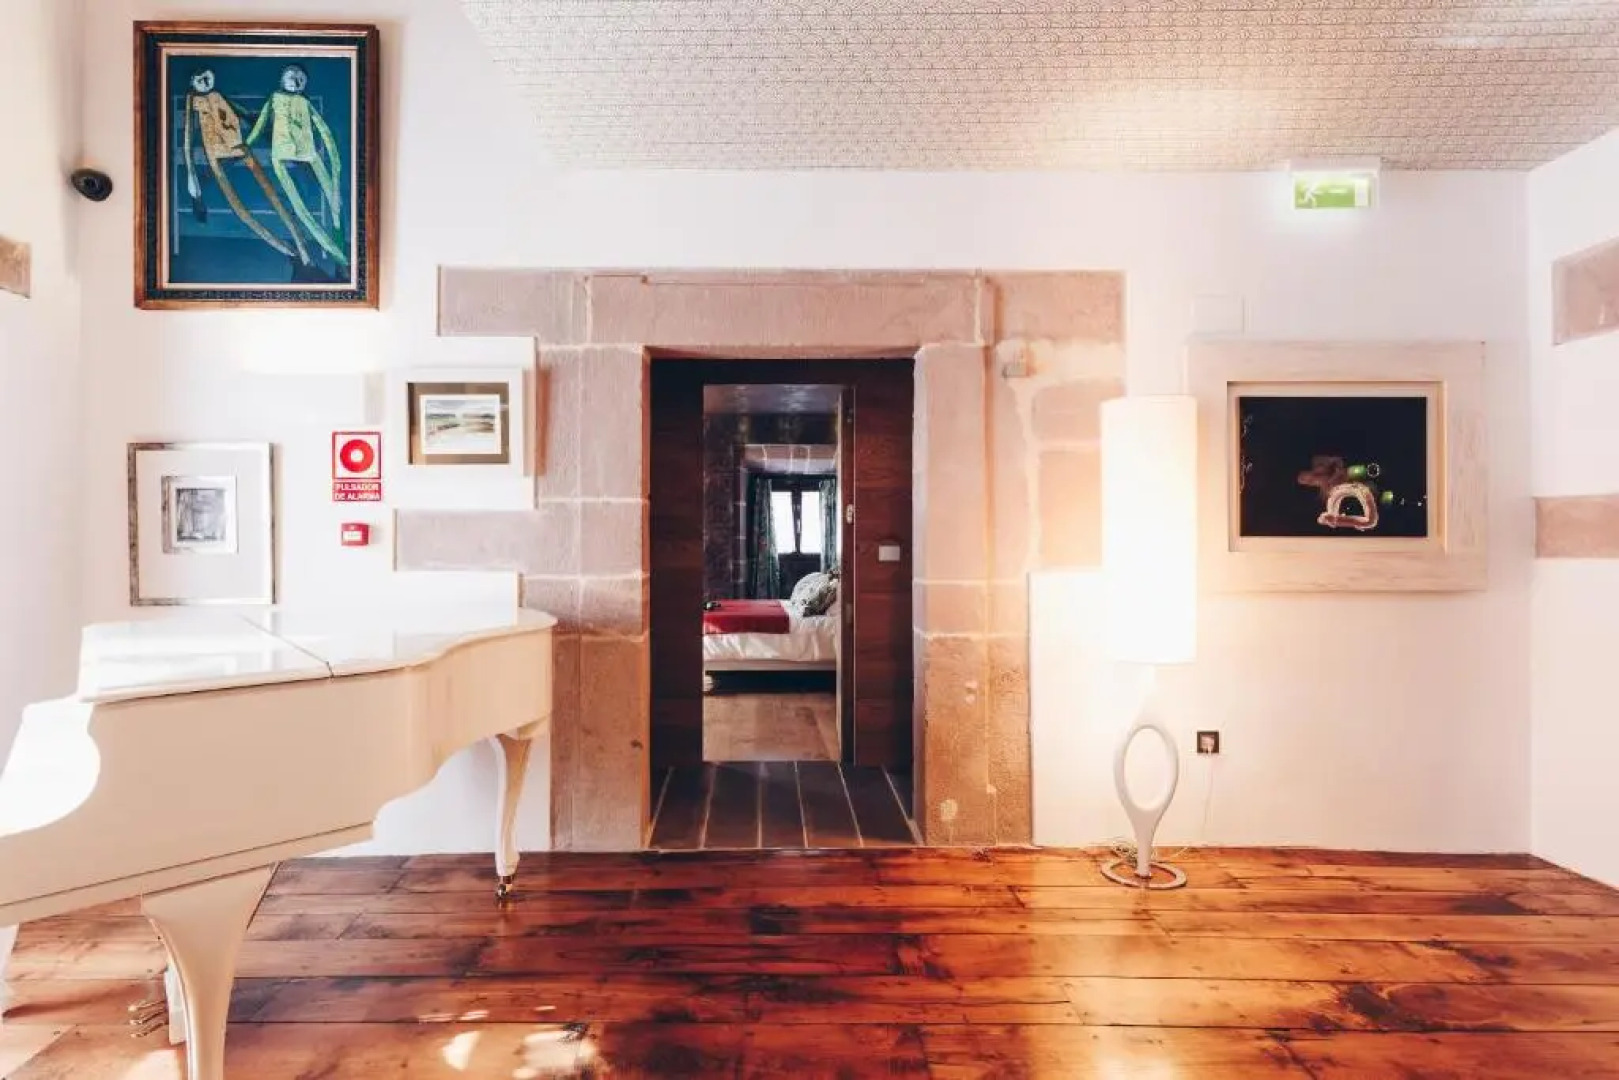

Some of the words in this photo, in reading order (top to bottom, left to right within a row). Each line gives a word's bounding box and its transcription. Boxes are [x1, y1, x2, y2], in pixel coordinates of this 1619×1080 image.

[335, 483, 379, 491] PULSADOR
[335, 491, 346, 500] DE
[347, 491, 380, 500] ALARMA
